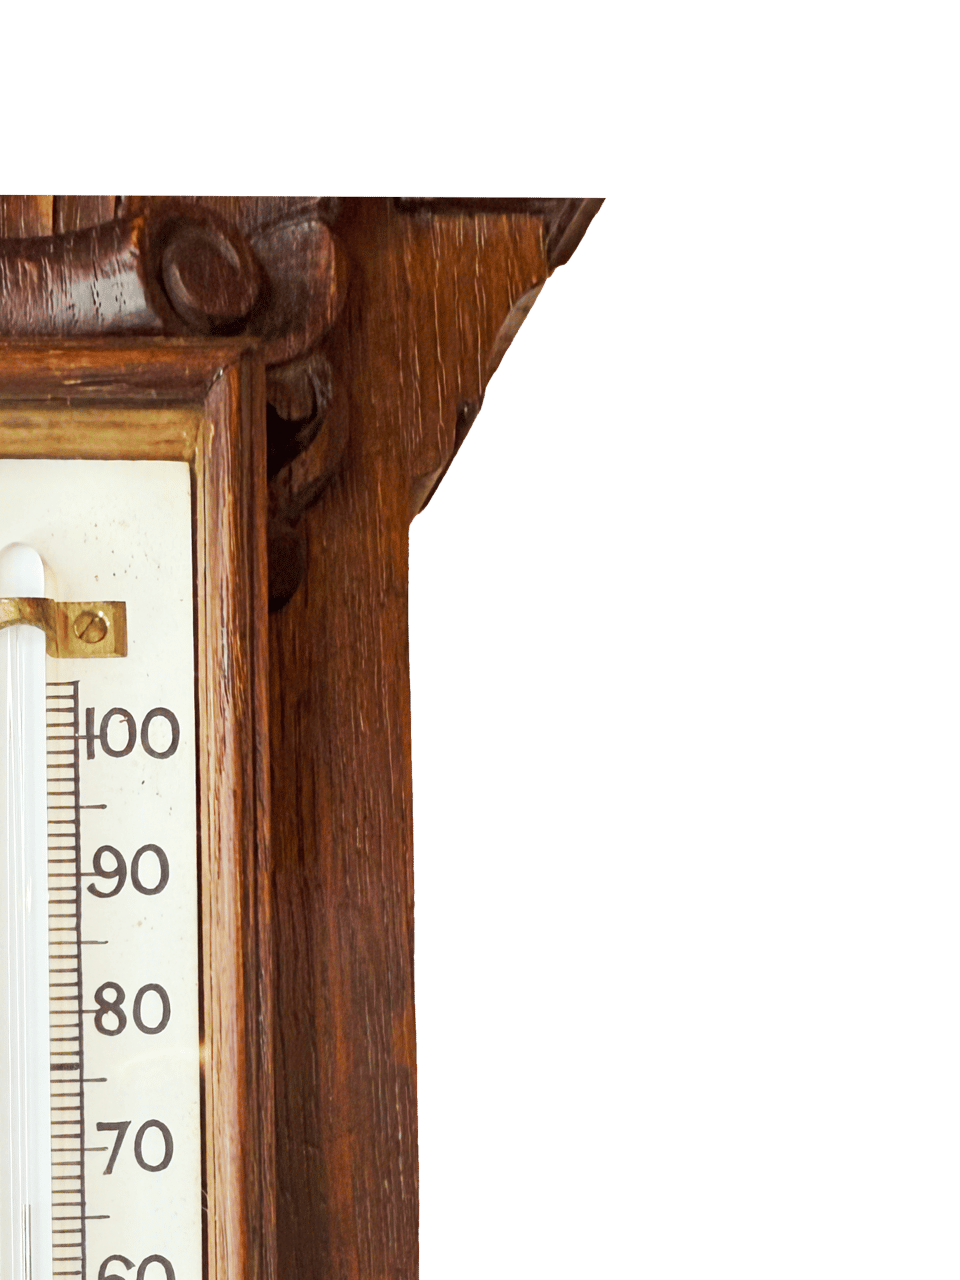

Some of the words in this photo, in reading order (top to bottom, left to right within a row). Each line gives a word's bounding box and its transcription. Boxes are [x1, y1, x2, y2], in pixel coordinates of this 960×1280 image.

[85, 706, 180, 760] 100
[86, 843, 170, 898] 90
[93, 981, 171, 1036] 80
[96, 1119, 174, 1175] 70
